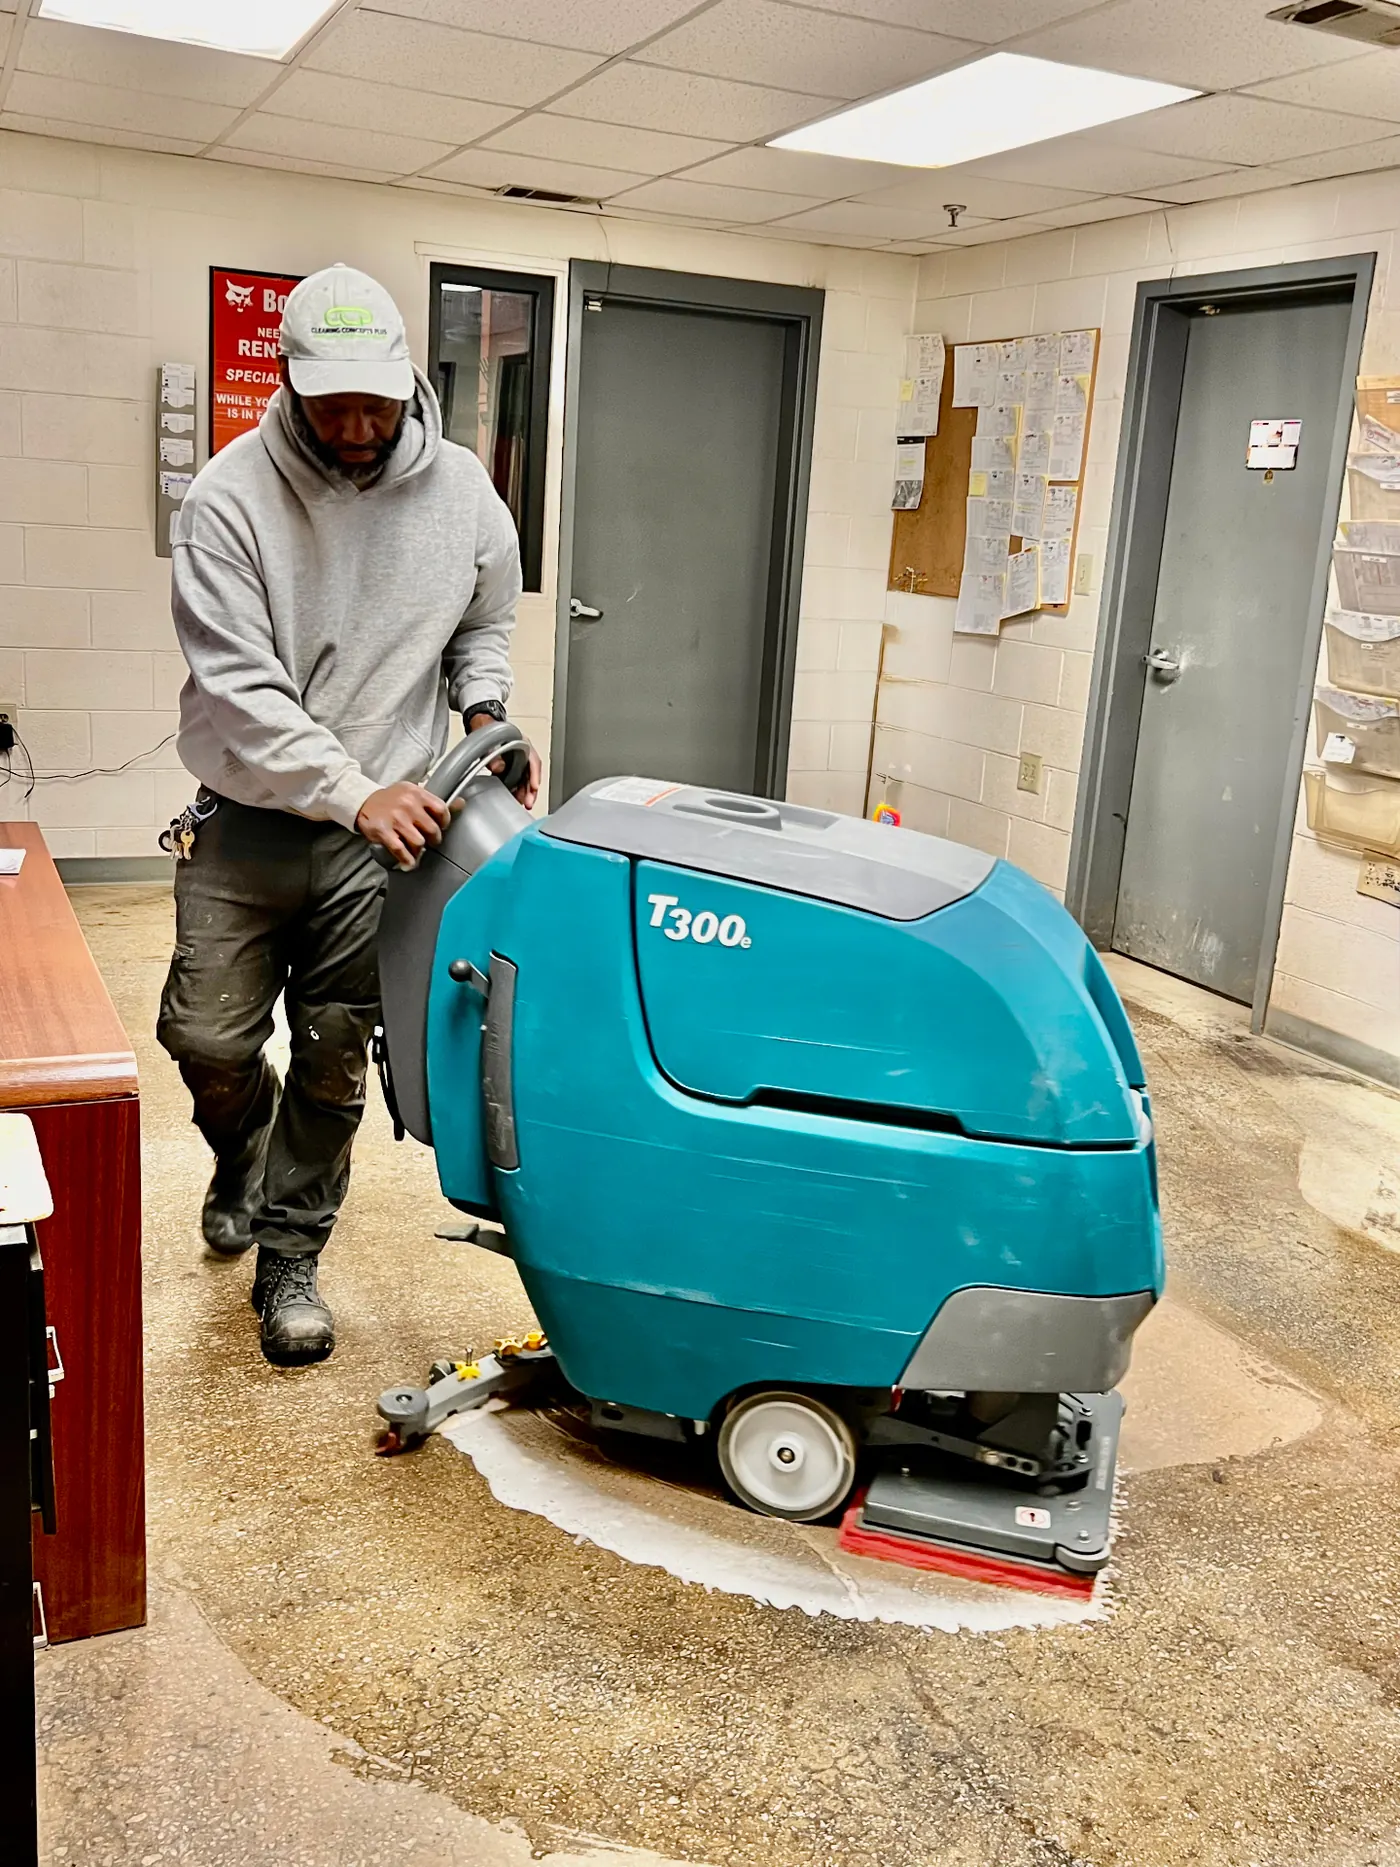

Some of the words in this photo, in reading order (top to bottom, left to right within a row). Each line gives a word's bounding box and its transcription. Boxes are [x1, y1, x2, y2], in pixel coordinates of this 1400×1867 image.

[263, 288, 290, 314] Bo
[257, 326, 281, 339] NEE
[238, 339, 281, 359] REN
[216, 393, 252, 407] WHILE
[255, 396, 269, 408] YO
[227, 408, 239, 419] IS
[241, 409, 254, 420] IN
[647, 894, 752, 949] T300e
